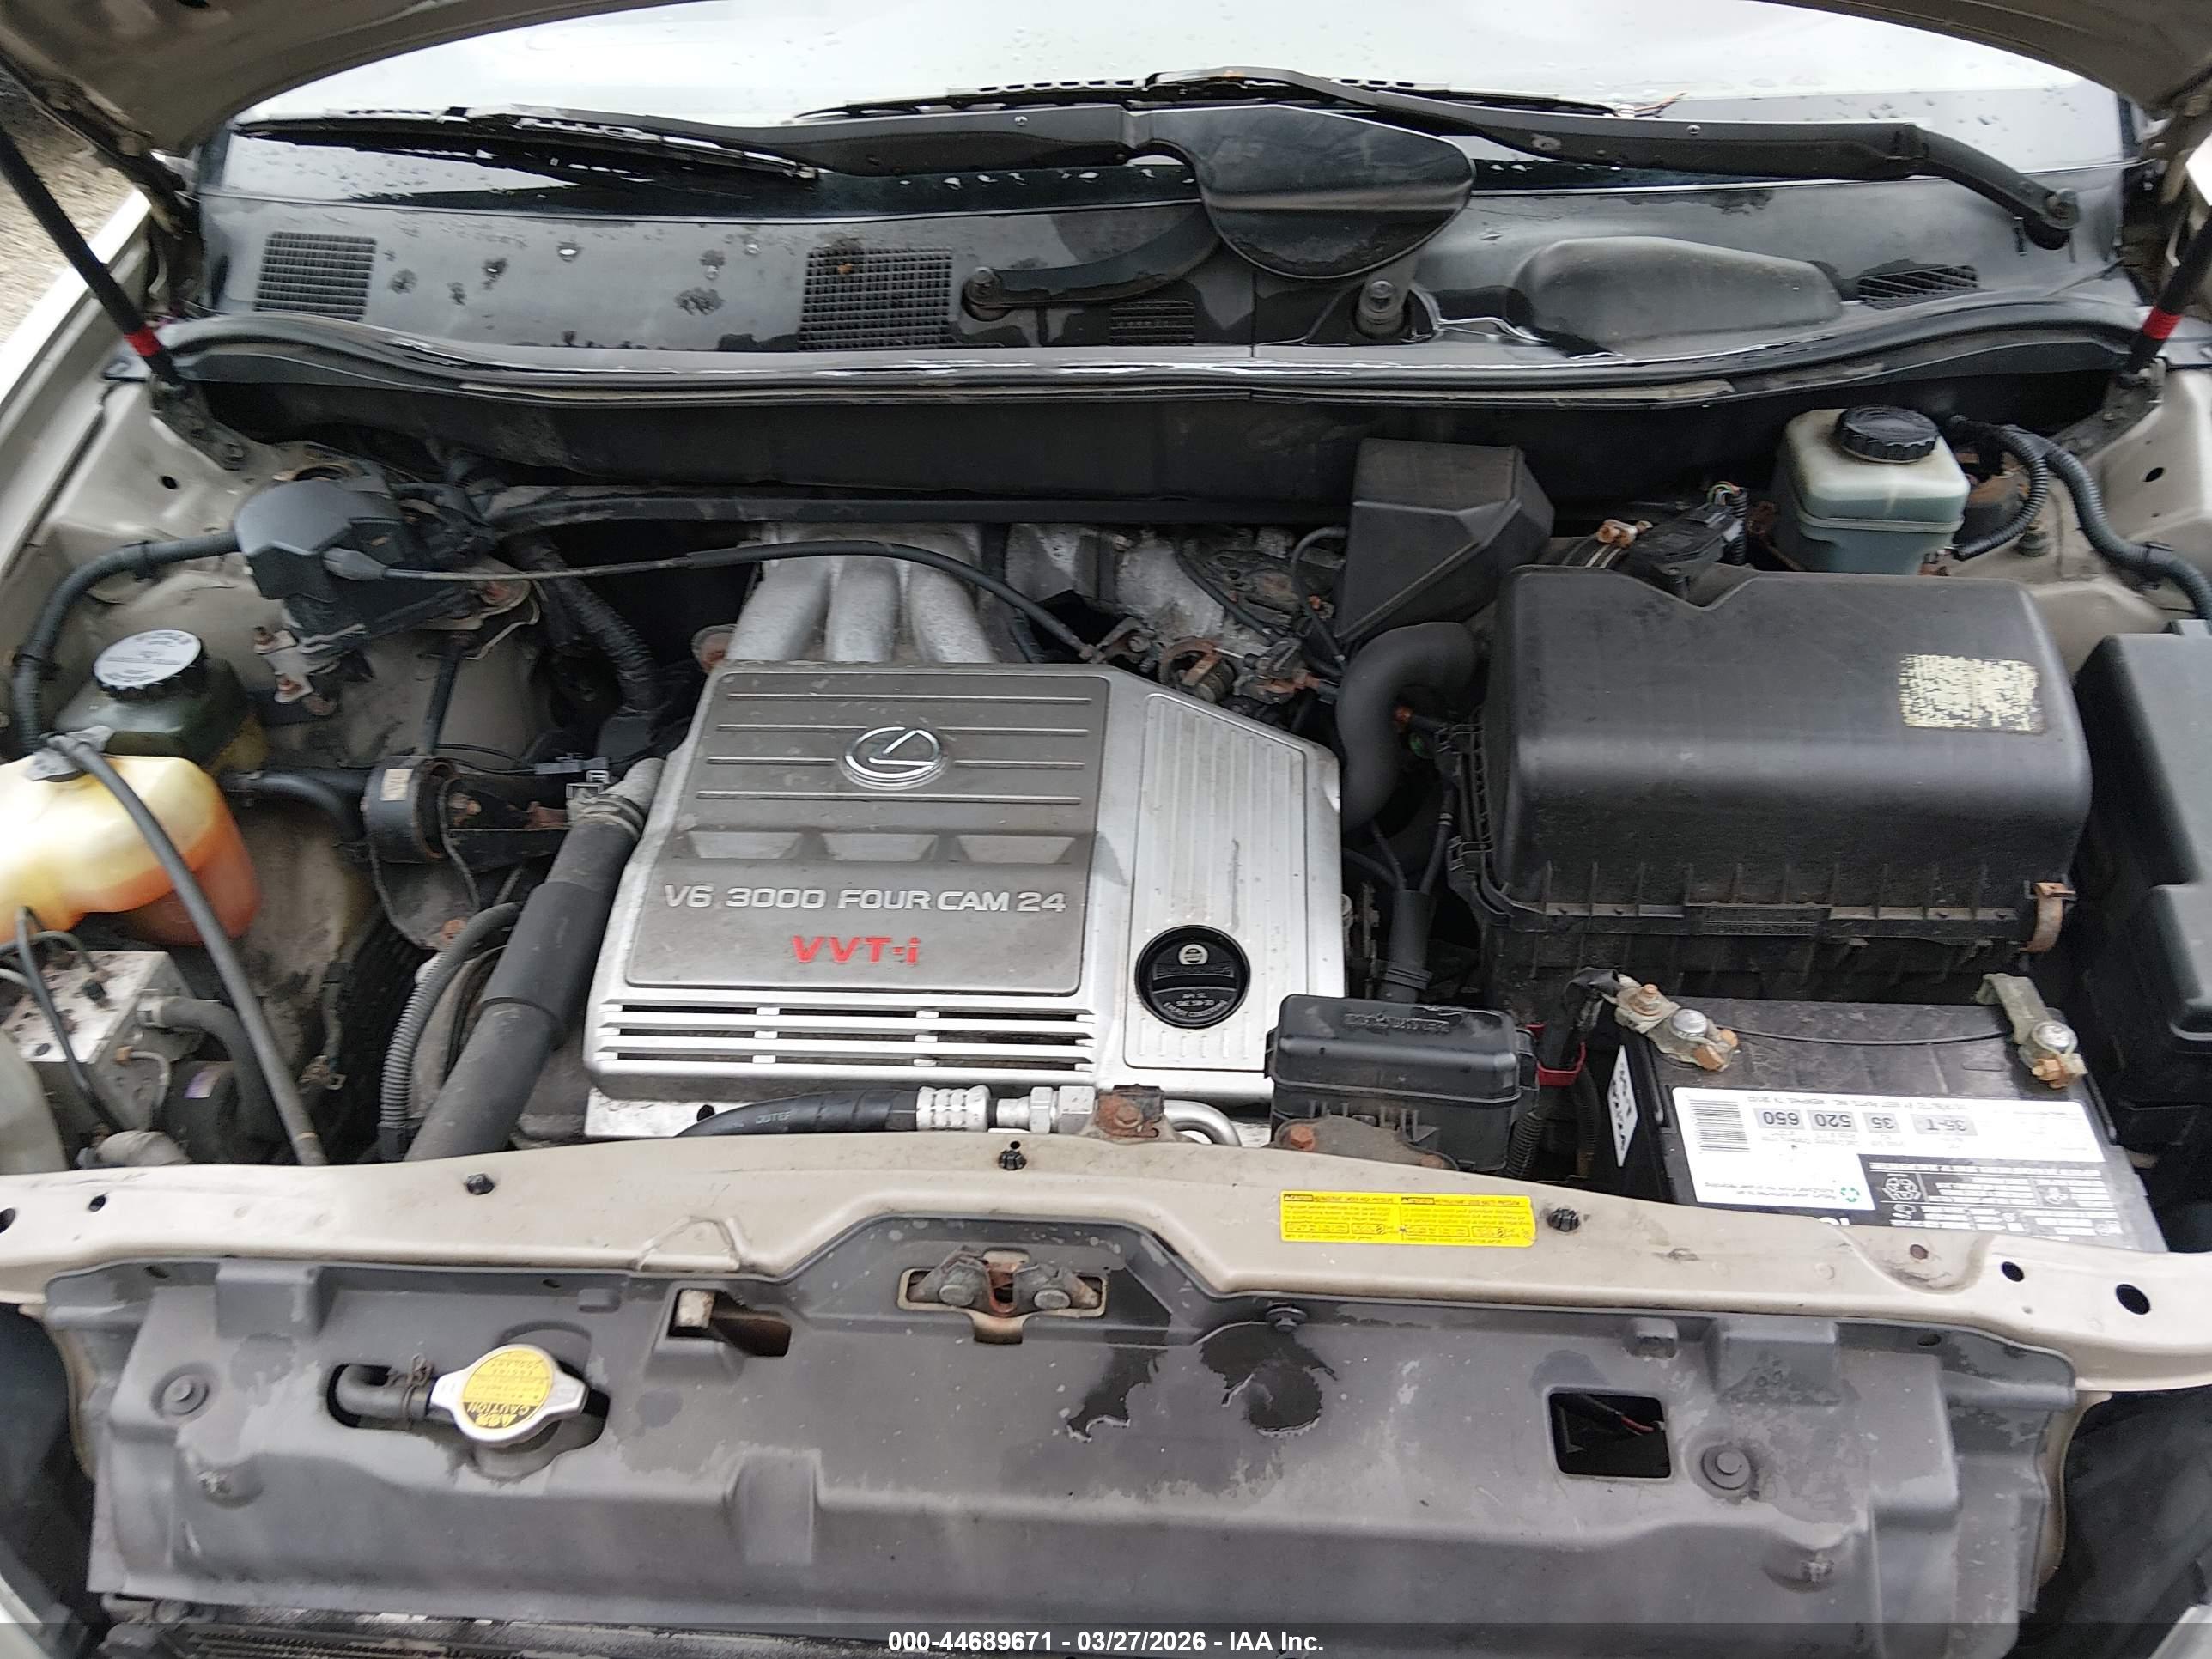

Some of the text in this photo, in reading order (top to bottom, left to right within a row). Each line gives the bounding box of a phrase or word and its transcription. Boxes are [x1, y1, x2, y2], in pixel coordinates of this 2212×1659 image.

[664, 884, 1066, 912] V6 3000 FOUR CAM 24
[792, 934, 921, 966] VVT-i
[1762, 1110, 1801, 1126] 650
[1814, 1113, 1852, 1128] 520
[1870, 1116, 1895, 1130] 35
[1925, 1118, 1967, 1132] 35-T
[466, 1401, 531, 1416] CAUTION
